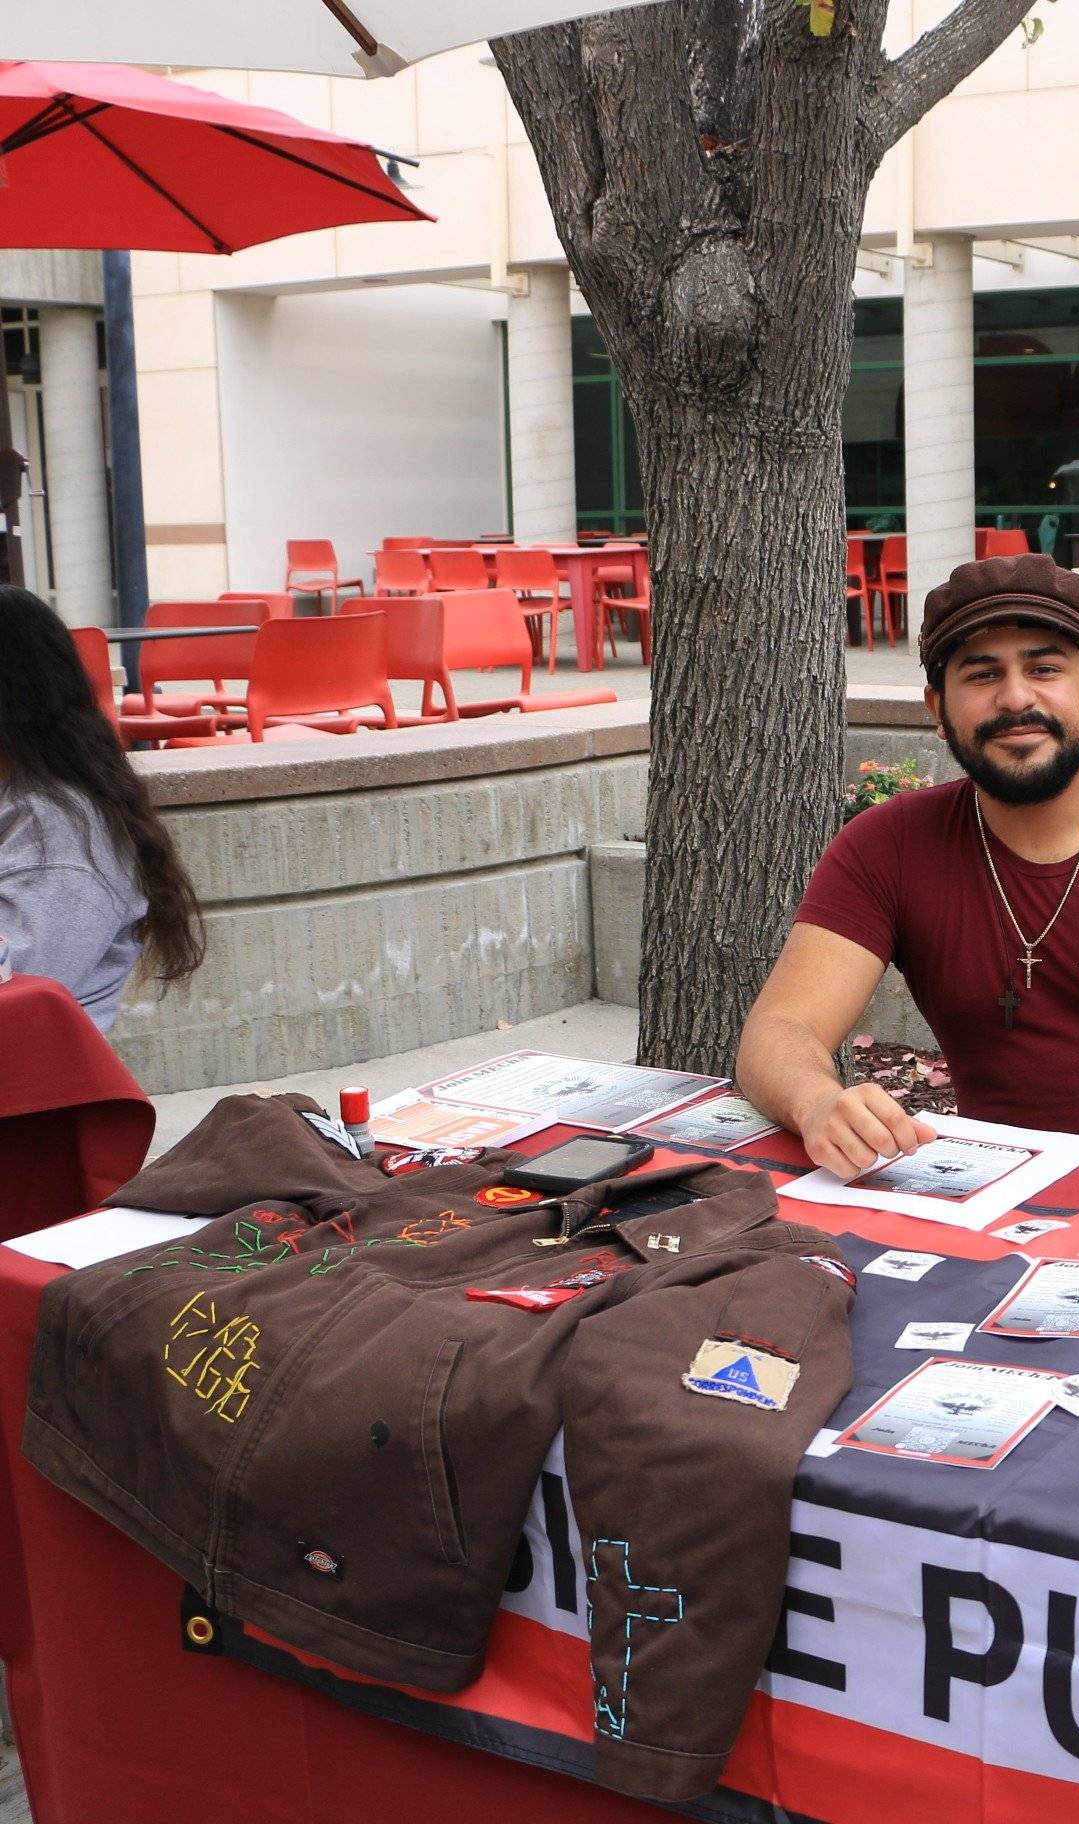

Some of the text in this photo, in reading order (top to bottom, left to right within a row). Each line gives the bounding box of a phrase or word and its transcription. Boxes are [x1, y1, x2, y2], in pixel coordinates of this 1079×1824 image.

[944, 1362, 984, 1372] Join
[728, 1368, 750, 1383] US
[764, 1530, 847, 1693] E
